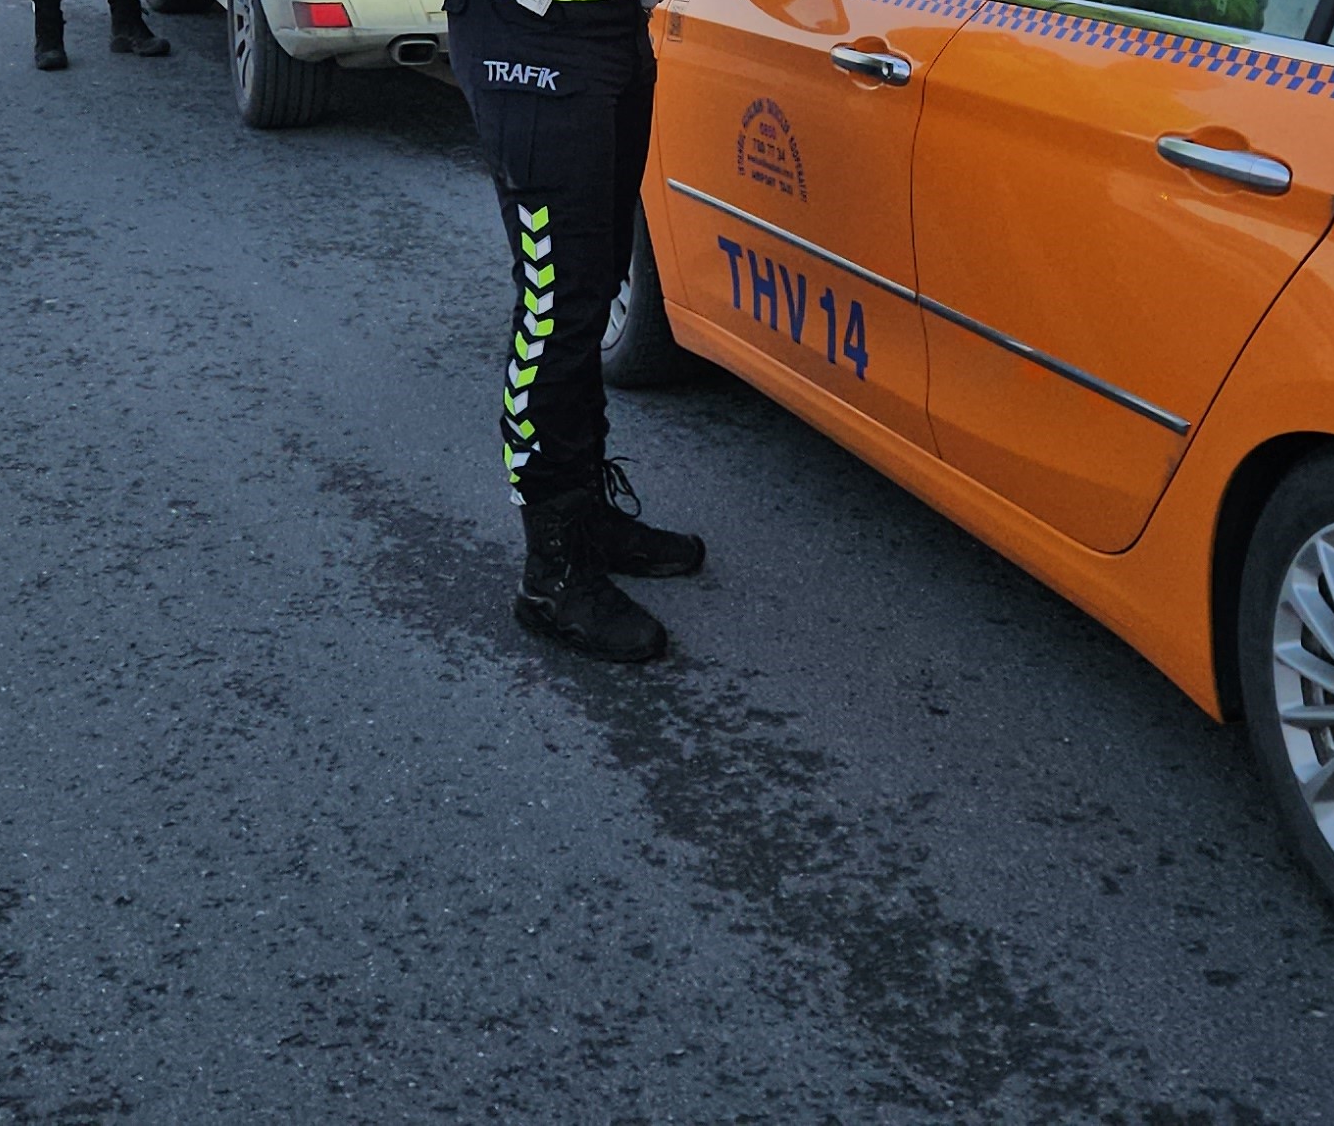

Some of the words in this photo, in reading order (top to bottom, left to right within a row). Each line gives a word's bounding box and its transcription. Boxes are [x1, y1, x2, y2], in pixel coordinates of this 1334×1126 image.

[483, 60, 561, 91] TRAFİK
[717, 234, 807, 346] THV
[819, 286, 869, 382] 14
